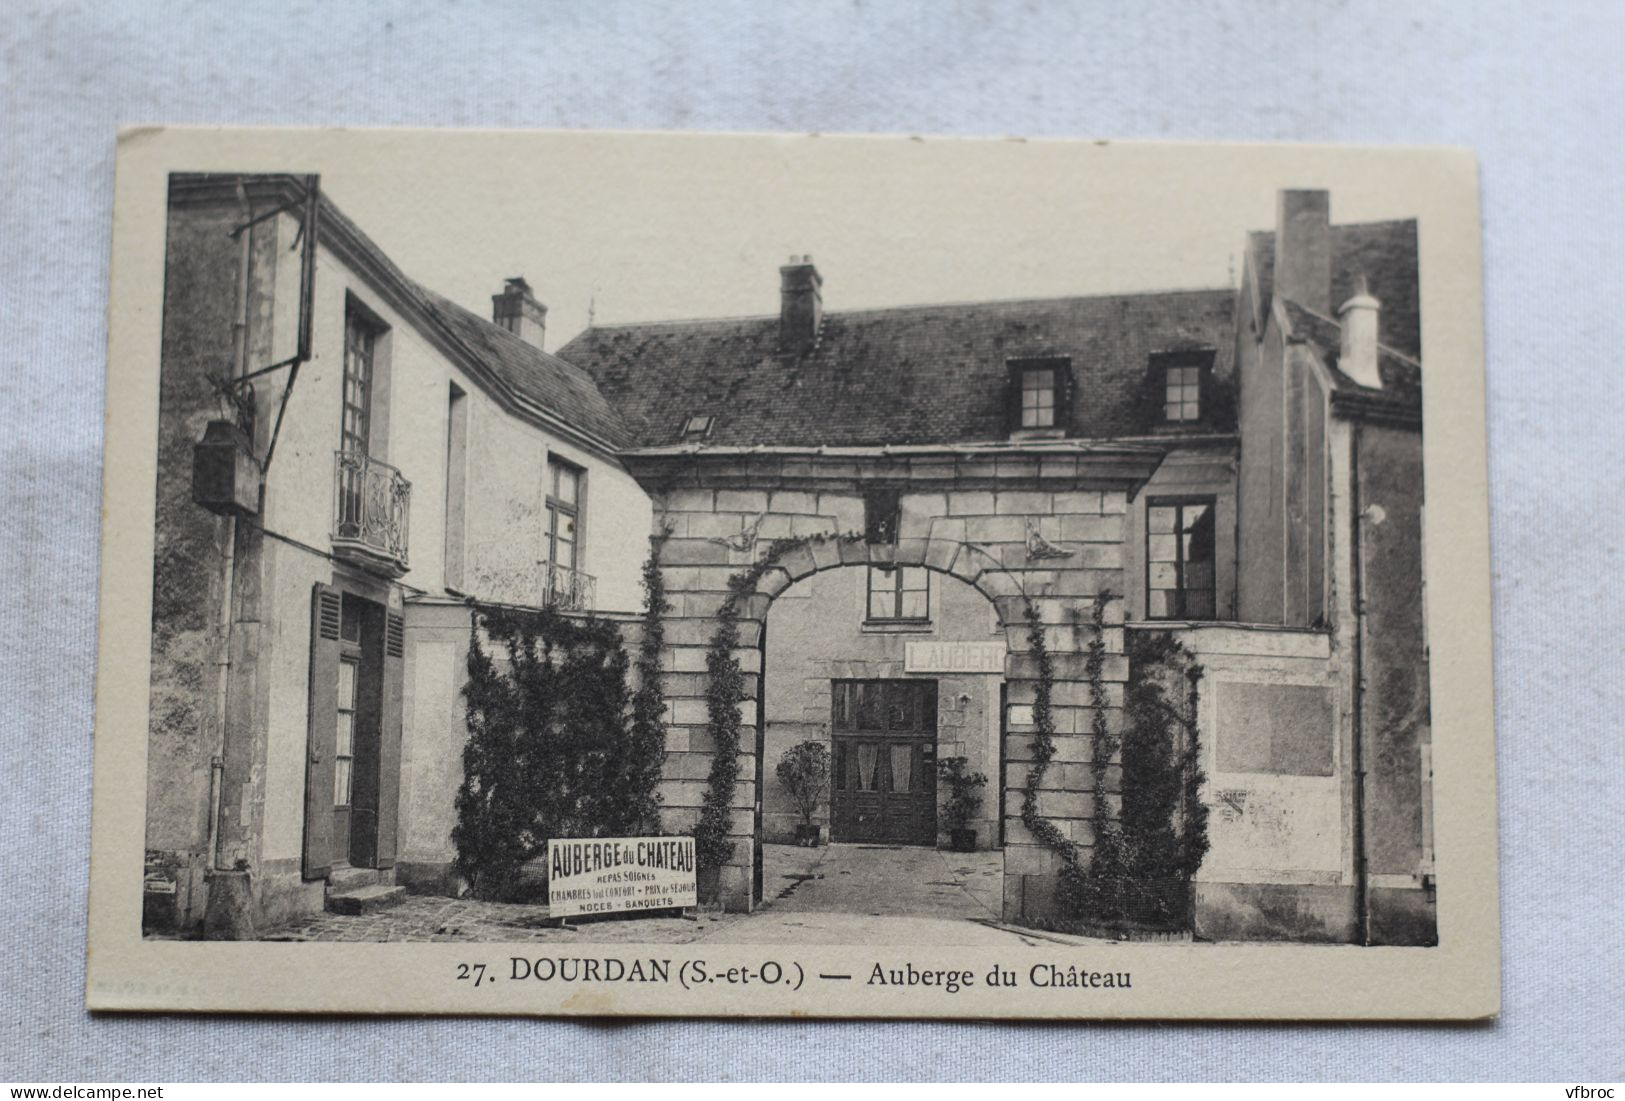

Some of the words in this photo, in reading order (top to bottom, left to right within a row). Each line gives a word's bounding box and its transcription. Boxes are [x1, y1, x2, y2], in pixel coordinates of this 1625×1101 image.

[551, 843, 622, 881] AUBERGE
[623, 845, 634, 864] du
[637, 841, 693, 872] CHATEAU
[597, 873, 621, 883] REPAS
[551, 888, 591, 902] CHAMBRES
[605, 885, 635, 897] CONFORT
[645, 884, 661, 895] PRIX
[662, 885, 669, 894] de
[579, 903, 612, 912] NOCES
[625, 898, 673, 908] BANQUETS
[456, 962, 496, 987] 27.
[509, 957, 672, 983] DOURDAN
[679, 960, 805, 990] (S.-et-O.)
[867, 962, 974, 993] Auberge
[985, 964, 1018, 987] du
[1029, 964, 1132, 988] Château
